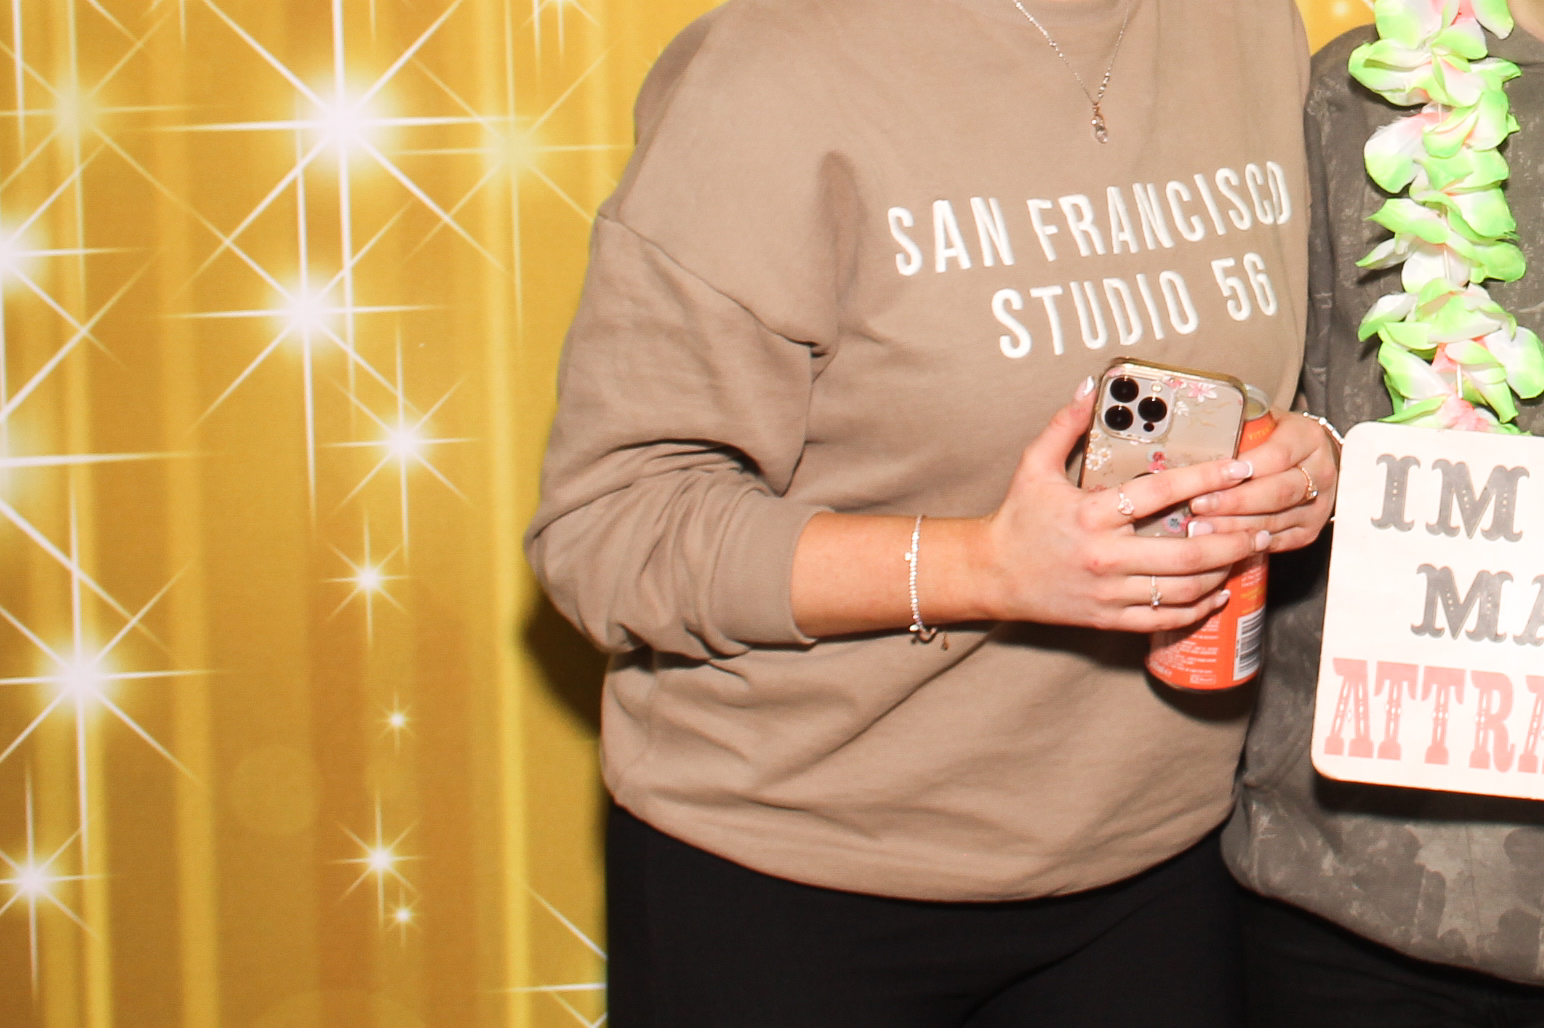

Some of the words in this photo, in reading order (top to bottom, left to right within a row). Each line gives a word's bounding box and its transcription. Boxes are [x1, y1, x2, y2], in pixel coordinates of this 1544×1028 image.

[887, 196, 1015, 276] SAN
[1026, 160, 1292, 262] FRANCISCO
[991, 270, 1199, 359] STUDIO
[1210, 252, 1278, 321] 56
